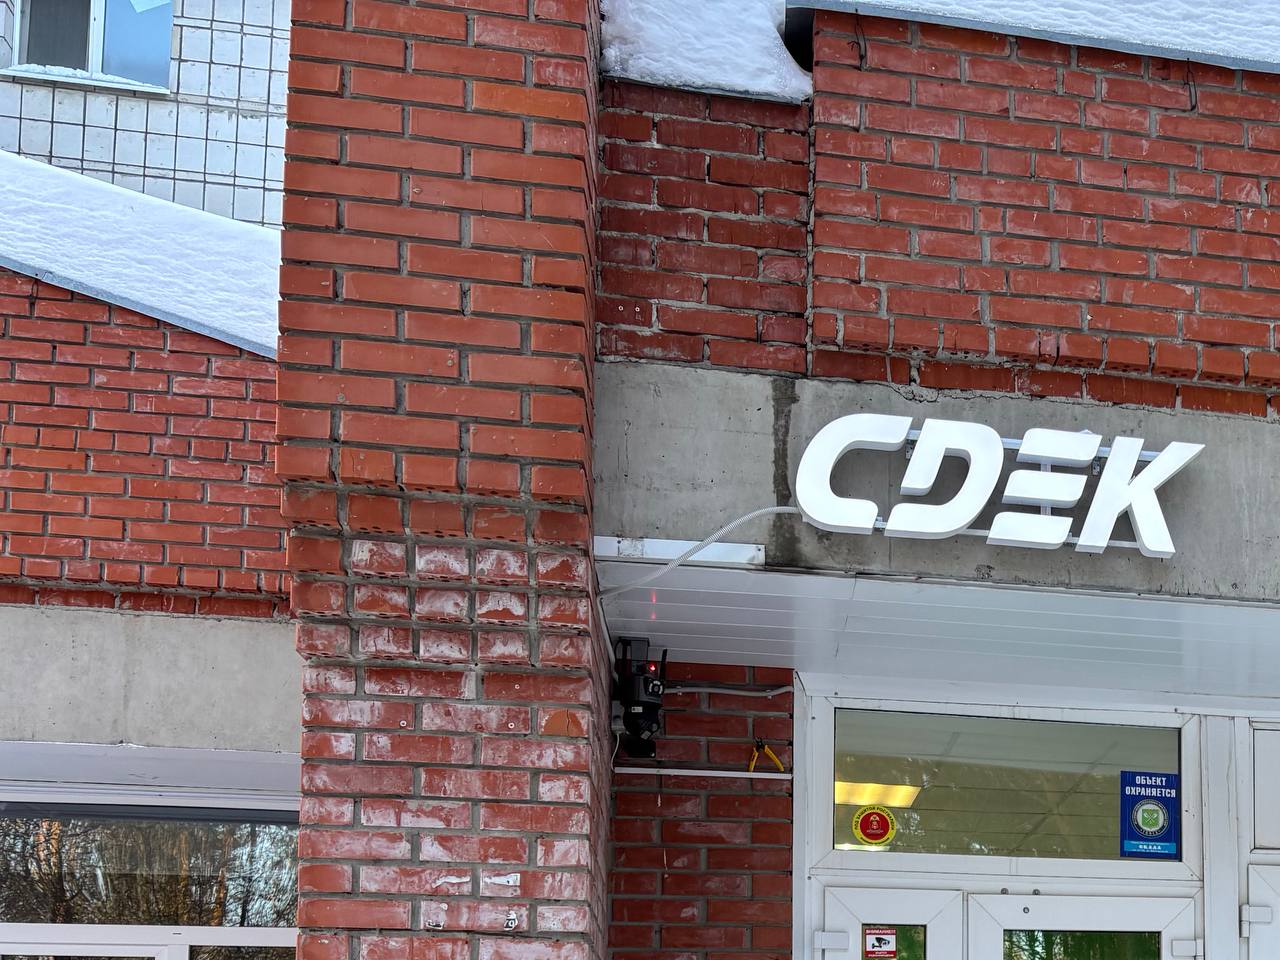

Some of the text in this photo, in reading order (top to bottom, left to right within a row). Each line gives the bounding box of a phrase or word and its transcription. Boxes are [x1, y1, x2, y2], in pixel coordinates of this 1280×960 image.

[796, 413, 1206, 559] CDEK
[1135, 775, 1167, 786] ОБЪЕКТ
[1125, 786, 1176, 798] ОХРАНЯЕТСЯ
